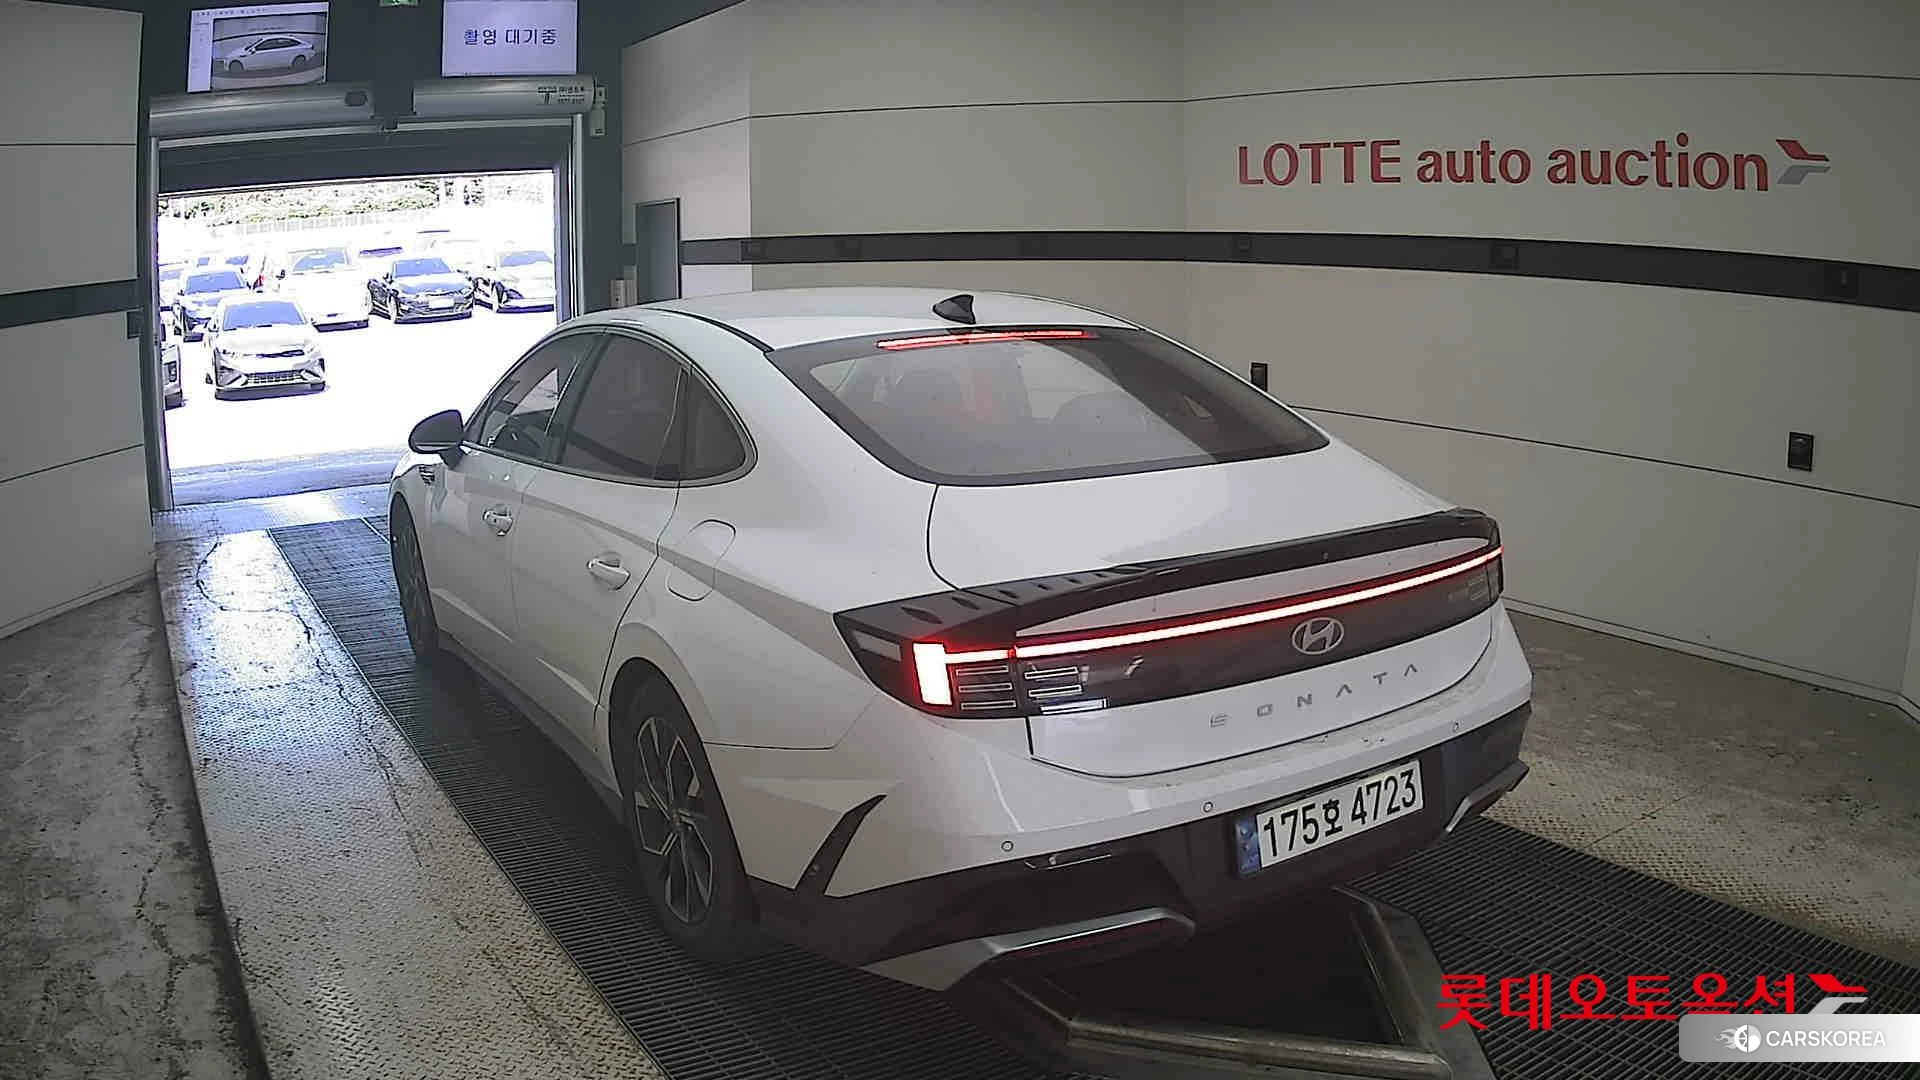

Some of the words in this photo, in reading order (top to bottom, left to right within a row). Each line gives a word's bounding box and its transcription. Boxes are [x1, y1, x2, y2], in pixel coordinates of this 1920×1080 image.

[464, 29, 498, 46] 촬영
[505, 28, 557, 45] 대기중
[1238, 139, 1401, 185] LOTTE
[1416, 140, 1531, 184] auto
[1547, 132, 1769, 191] auction
[1210, 663, 1418, 728] SONATA
[1263, 799, 1343, 857] 175호
[1351, 769, 1416, 825] 4723
